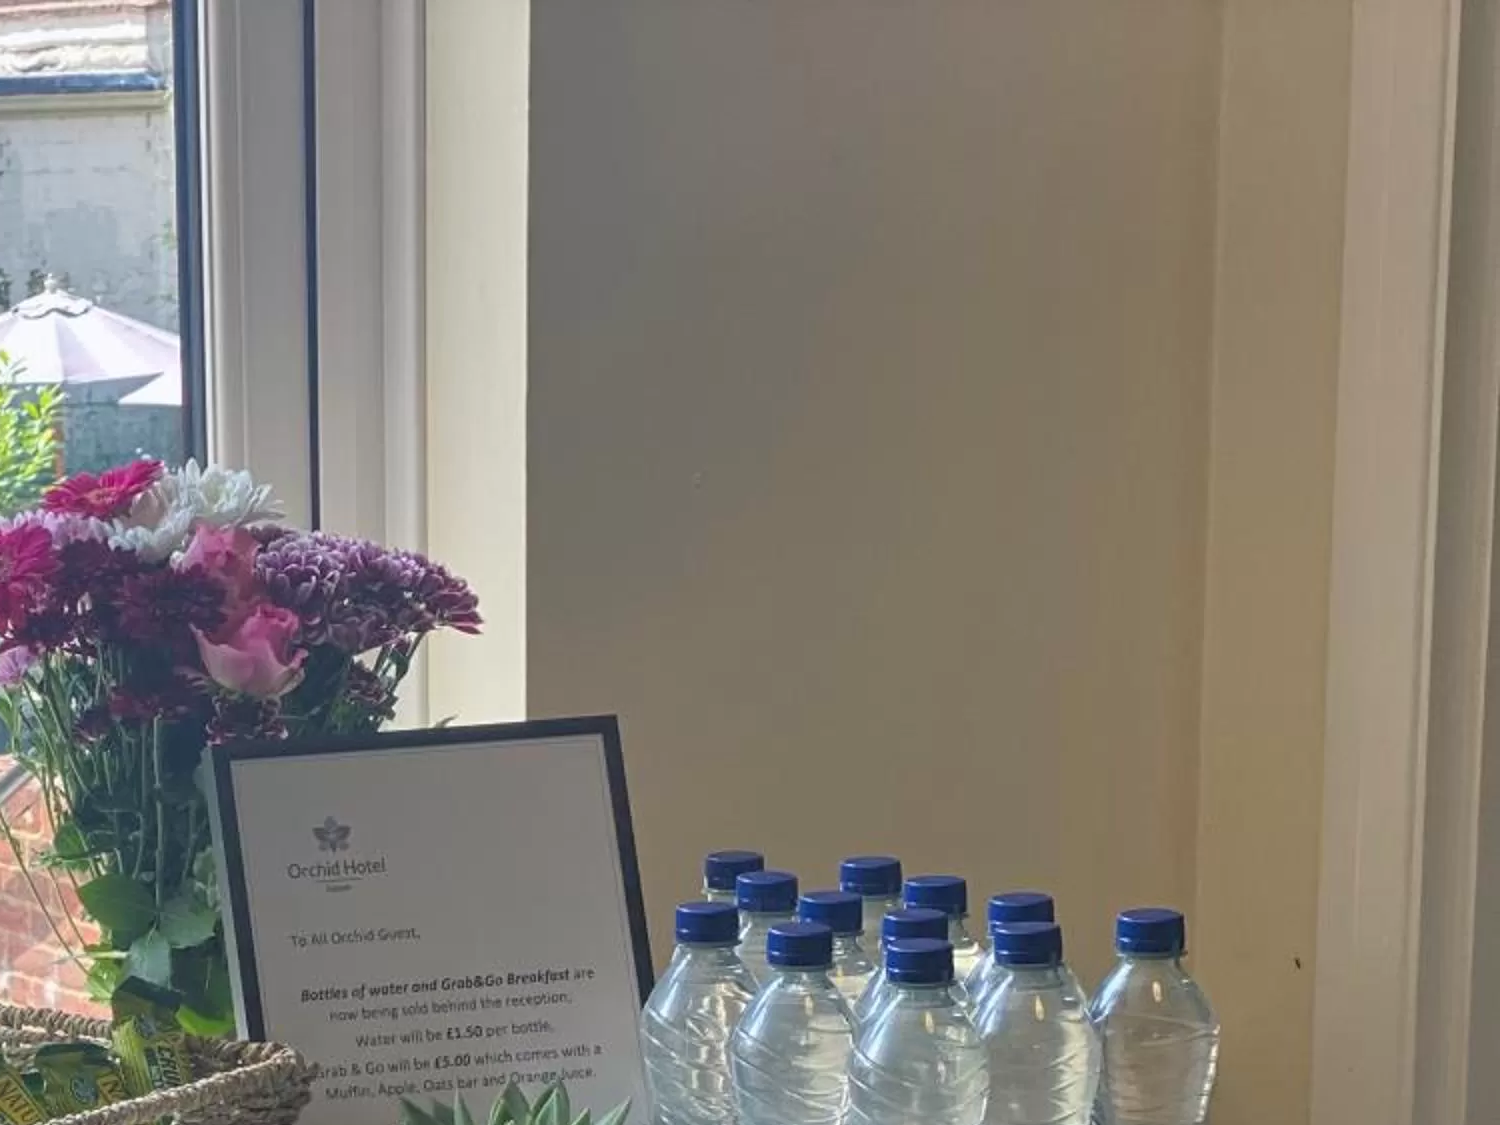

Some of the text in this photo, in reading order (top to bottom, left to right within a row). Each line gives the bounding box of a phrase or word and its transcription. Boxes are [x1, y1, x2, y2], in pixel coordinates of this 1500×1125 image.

[287, 856, 387, 879] Orchid Hotel
[291, 935, 306, 947] To
[311, 932, 329, 944] All
[332, 928, 374, 944] Orchid
[301, 968, 595, 1002] Bottles of water and Grab&Go Breakfast are
[329, 992, 572, 1021] now being sold behind the reception.
[356, 1020, 554, 1047] Water will be £1.50 per bottle.
[351, 1063, 362, 1075] &
[365, 1060, 385, 1075] Go
[387, 1060, 411, 1073] will
[413, 1056, 431, 1070] be
[435, 1053, 471, 1069] £5.00
[474, 1050, 512, 1065] which
[516, 1049, 559, 1062] comes
[561, 1044, 590, 1057] with
[325, 1085, 376, 1099] Muffin,
[379, 1081, 421, 1097] Apple,
[424, 1078, 453, 1092] Oats
[457, 1076, 477, 1089] bar
[483, 1073, 506, 1087] and
[509, 1070, 557, 1086] Orange
